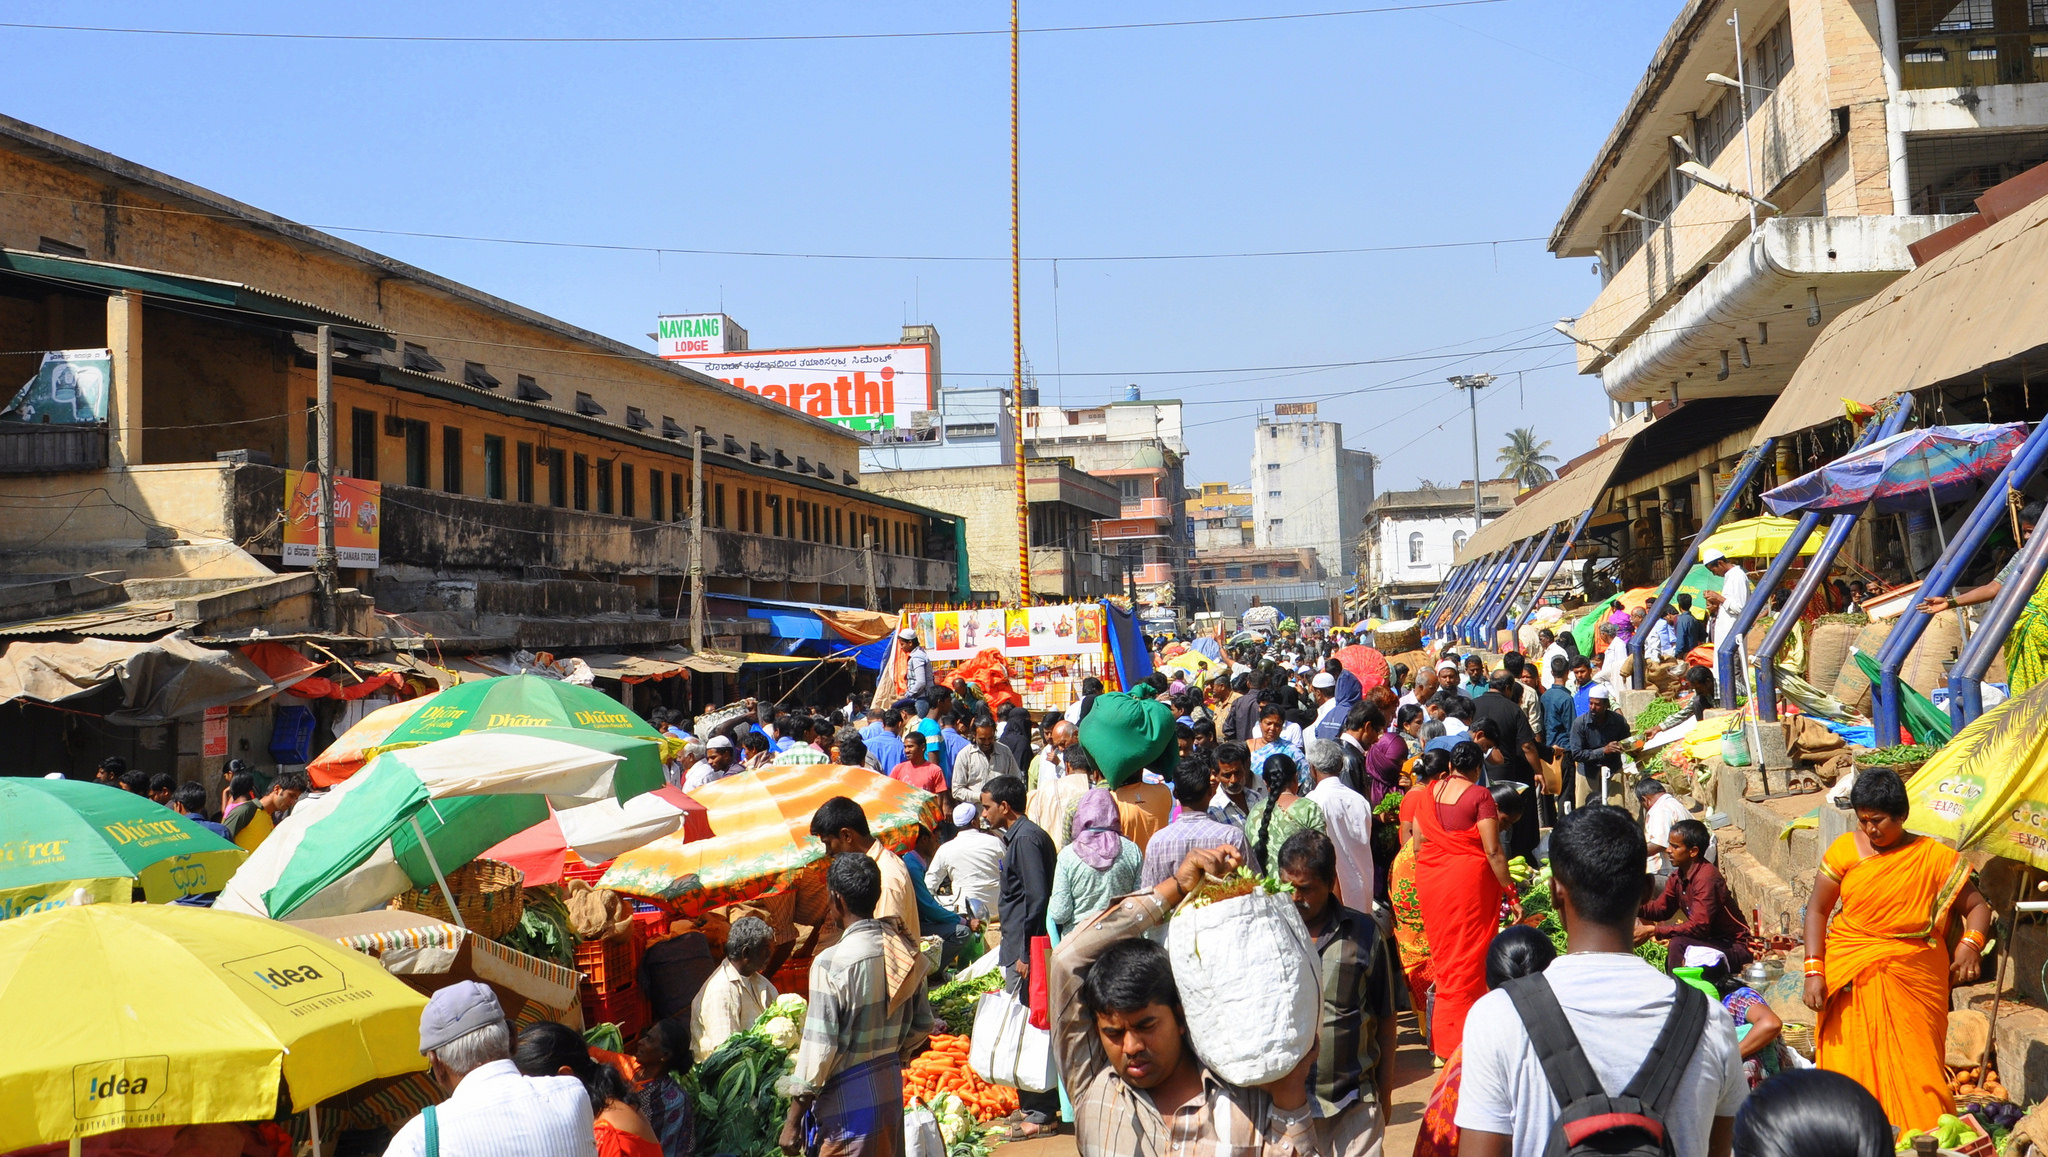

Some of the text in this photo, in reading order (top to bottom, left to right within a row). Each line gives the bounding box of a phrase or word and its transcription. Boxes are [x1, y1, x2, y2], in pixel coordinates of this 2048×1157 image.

[660, 318, 719, 338] NAVRANG
[675, 340, 709, 352] LODGE
[343, 551, 360, 560] CANARA
[361, 553, 377, 562] STORES
[2018, 832, 2048, 853] EXPR
[290, 989, 374, 1017] ADITYA BIRLA GROUP
[73, 1120, 106, 1133] ADITYA
[138, 1113, 166, 1123] GROUP
